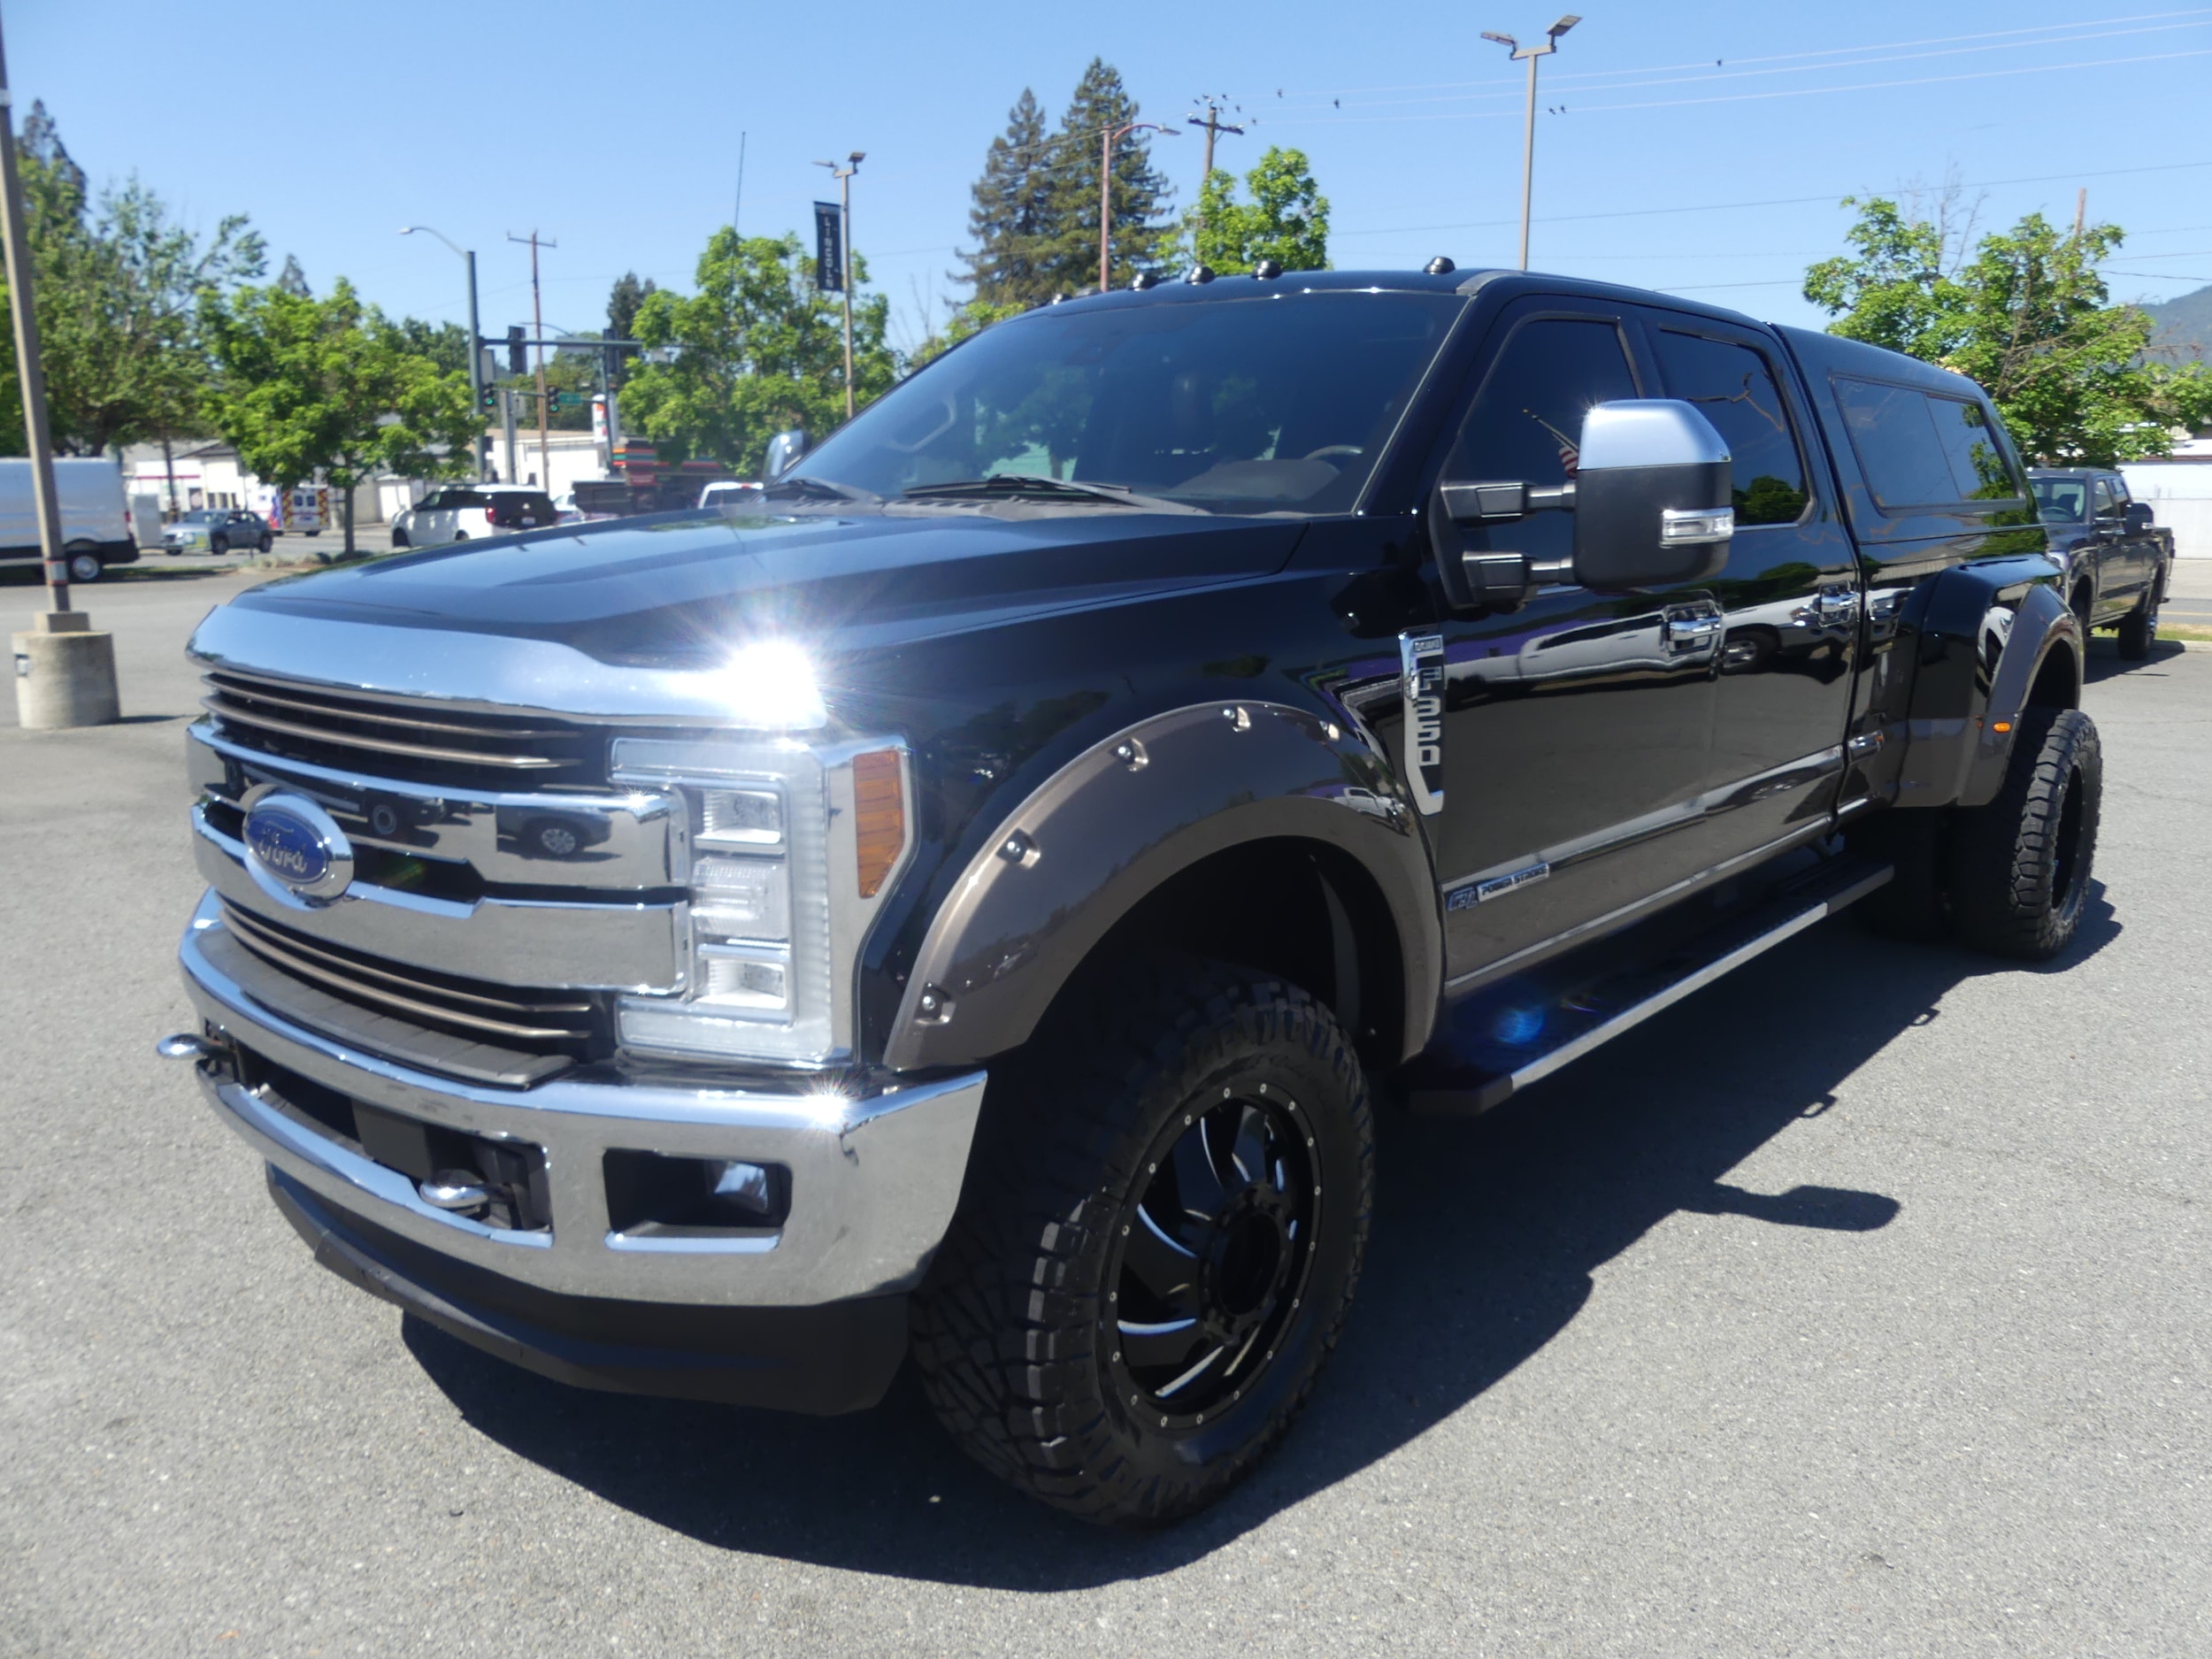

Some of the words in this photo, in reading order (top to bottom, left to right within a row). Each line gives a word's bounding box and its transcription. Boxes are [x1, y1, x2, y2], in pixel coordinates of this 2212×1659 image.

[824, 216, 833, 288] LINCOLN
[257, 819, 307, 873] Ford
[1481, 878, 1512, 895] POWER
